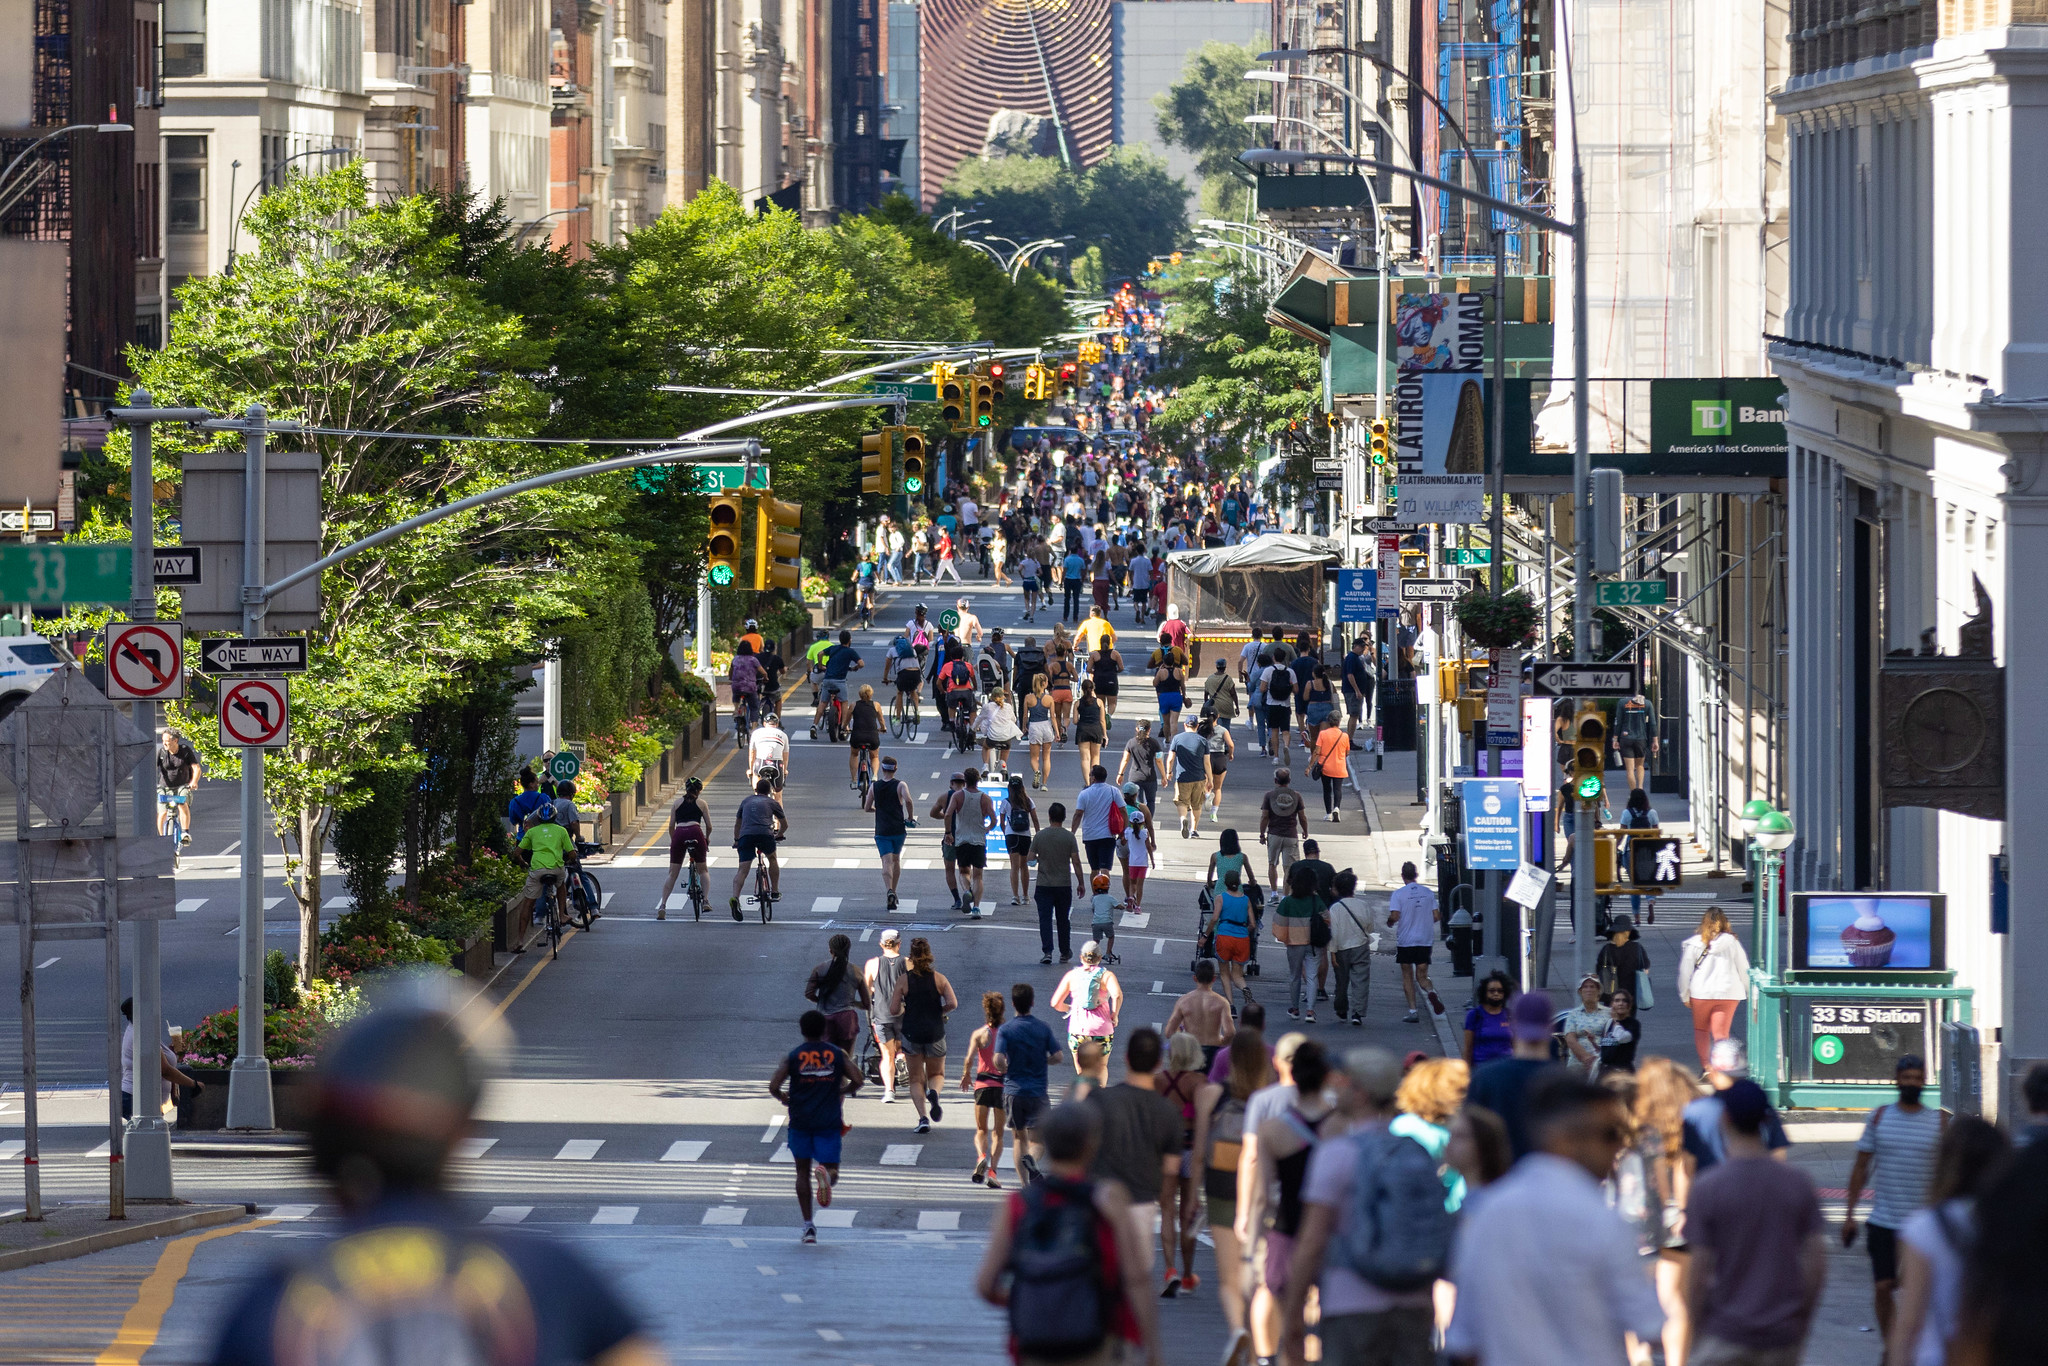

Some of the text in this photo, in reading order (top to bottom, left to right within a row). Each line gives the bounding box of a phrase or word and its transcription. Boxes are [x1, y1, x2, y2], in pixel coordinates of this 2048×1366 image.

[1458, 292, 1484, 374] NOMAD
[903, 386, 913, 398] St
[1398, 369, 1424, 475] FLATIRON
[1696, 406, 1728, 429] TD
[1668, 444, 1789, 454] America's Most Convenien
[707, 470, 726, 489] St
[1399, 475, 1483, 485] FLATIRONNOMAD.NYC
[1424, 499, 1477, 512] WILLIAMS
[1371, 521, 1387, 529] ONE
[1393, 521, 1410, 529] WAY
[1449, 550, 1457, 563] E
[1462, 550, 1474, 563] 31
[154, 558, 186, 574] WAY
[27, 551, 66, 601] 33
[1407, 585, 1462, 595] ONE WAY
[1600, 584, 1660, 604] E 32 ST
[942, 613, 958, 627] GO
[217, 648, 293, 663] ONE WAY
[1549, 673, 1624, 687] ONE WAY
[554, 760, 576, 775] GO
[1474, 817, 1512, 826] CAUTION
[1812, 1007, 1921, 1023] 33 St Station
[1812, 1024, 1870, 1034] Downtown
[1820, 1041, 1836, 1058] 6
[799, 1050, 835, 1071] 26.2
